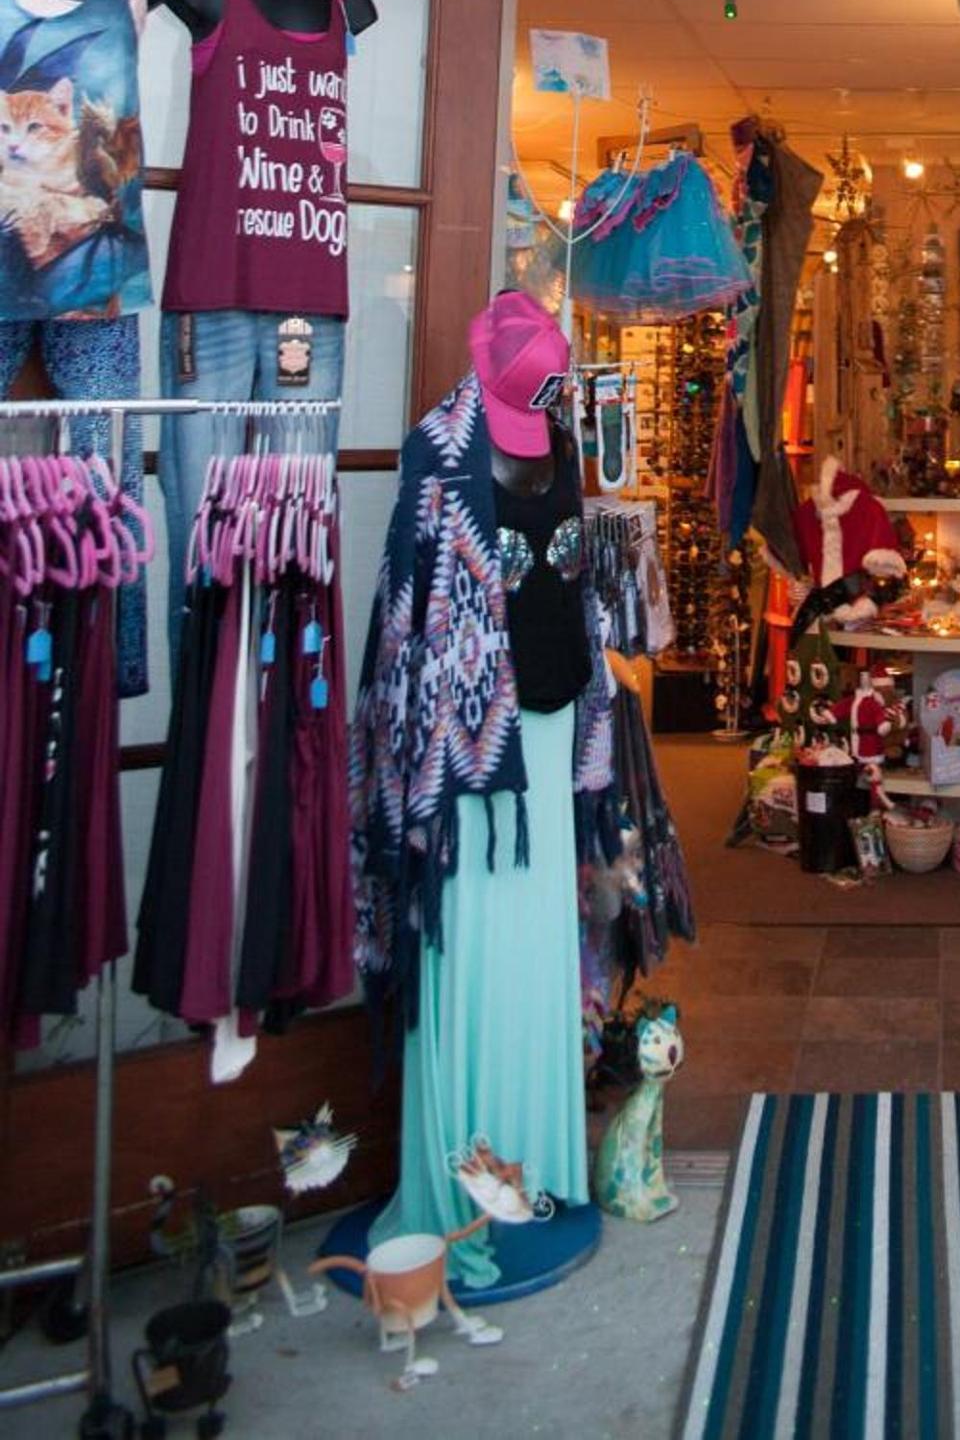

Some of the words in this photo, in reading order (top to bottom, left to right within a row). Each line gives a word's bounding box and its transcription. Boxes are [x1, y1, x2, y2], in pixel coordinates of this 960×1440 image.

[235, 54, 247, 91] i
[253, 56, 297, 100] just
[238, 101, 259, 136] to
[268, 104, 316, 142] Drink
[237, 145, 304, 194] Wine
[308, 164, 325, 194] &
[299, 199, 347, 256] Dog
